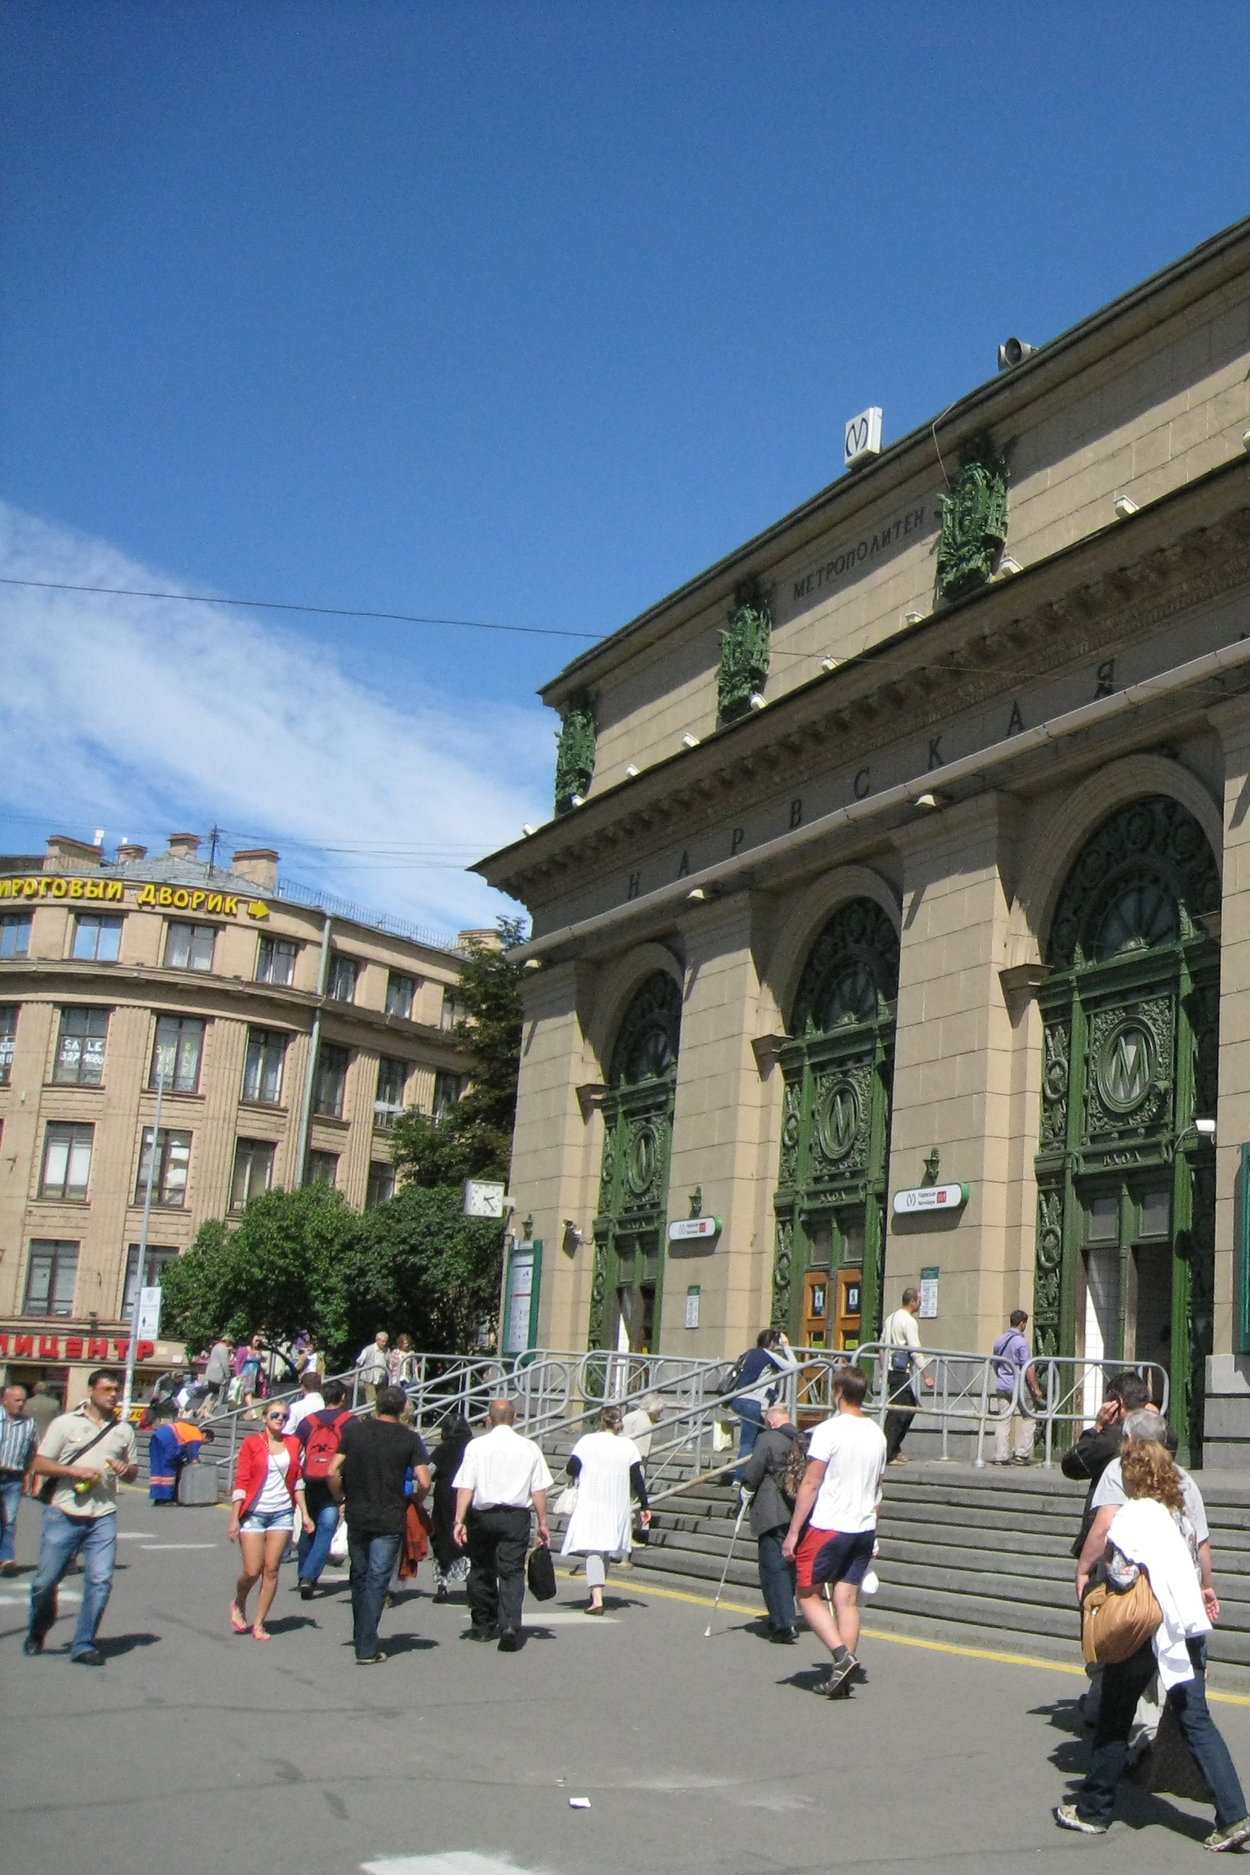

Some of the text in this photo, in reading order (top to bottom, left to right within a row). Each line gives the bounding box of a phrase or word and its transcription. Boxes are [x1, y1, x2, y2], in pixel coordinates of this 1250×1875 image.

[793, 506, 926, 599] МЕТРОПОЛИТЕН
[628, 657, 1116, 898] НАРВСКАЯ
[137, 884, 239, 915] ДВОРИК
